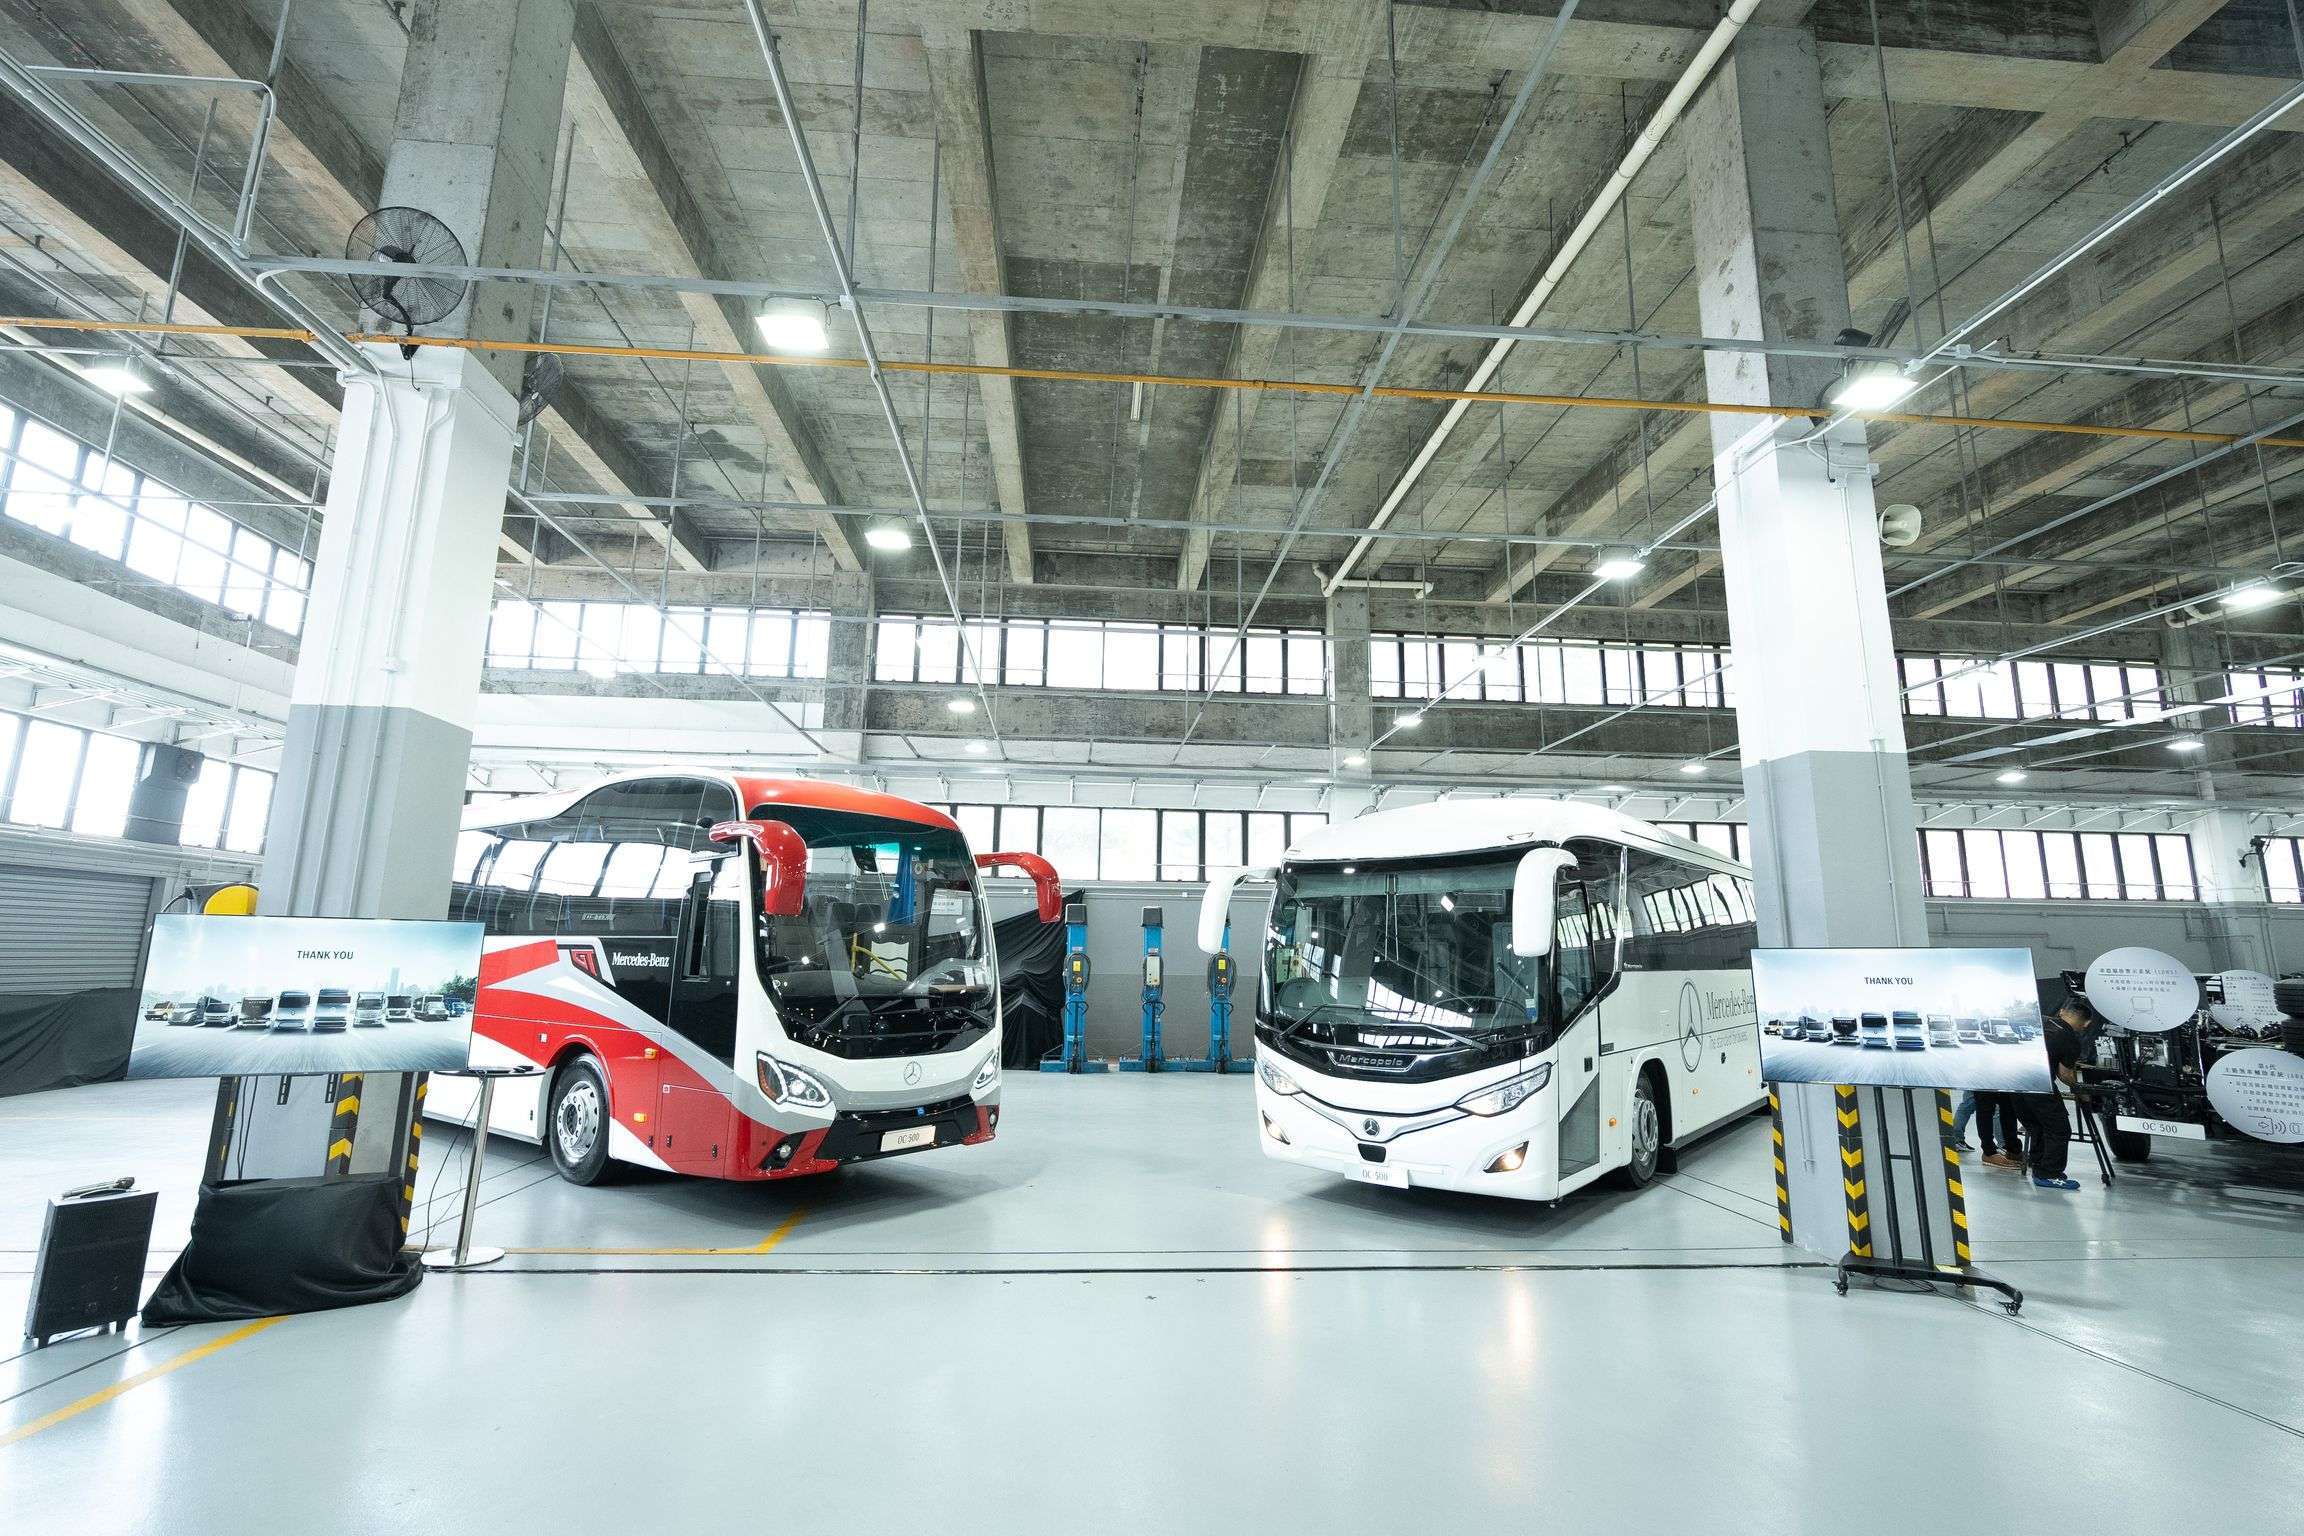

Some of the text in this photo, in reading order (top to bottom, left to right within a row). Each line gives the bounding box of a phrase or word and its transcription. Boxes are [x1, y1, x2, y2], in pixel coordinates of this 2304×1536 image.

[297, 950, 354, 960] THANK YOU
[611, 952, 670, 967] Mercedes-Benz
[1864, 976, 1913, 985] THANK YOU
[1340, 1054, 1403, 1066] Marcopolo
[2142, 1121, 2178, 1134] OC 500
[897, 1132, 920, 1144] OC 500
